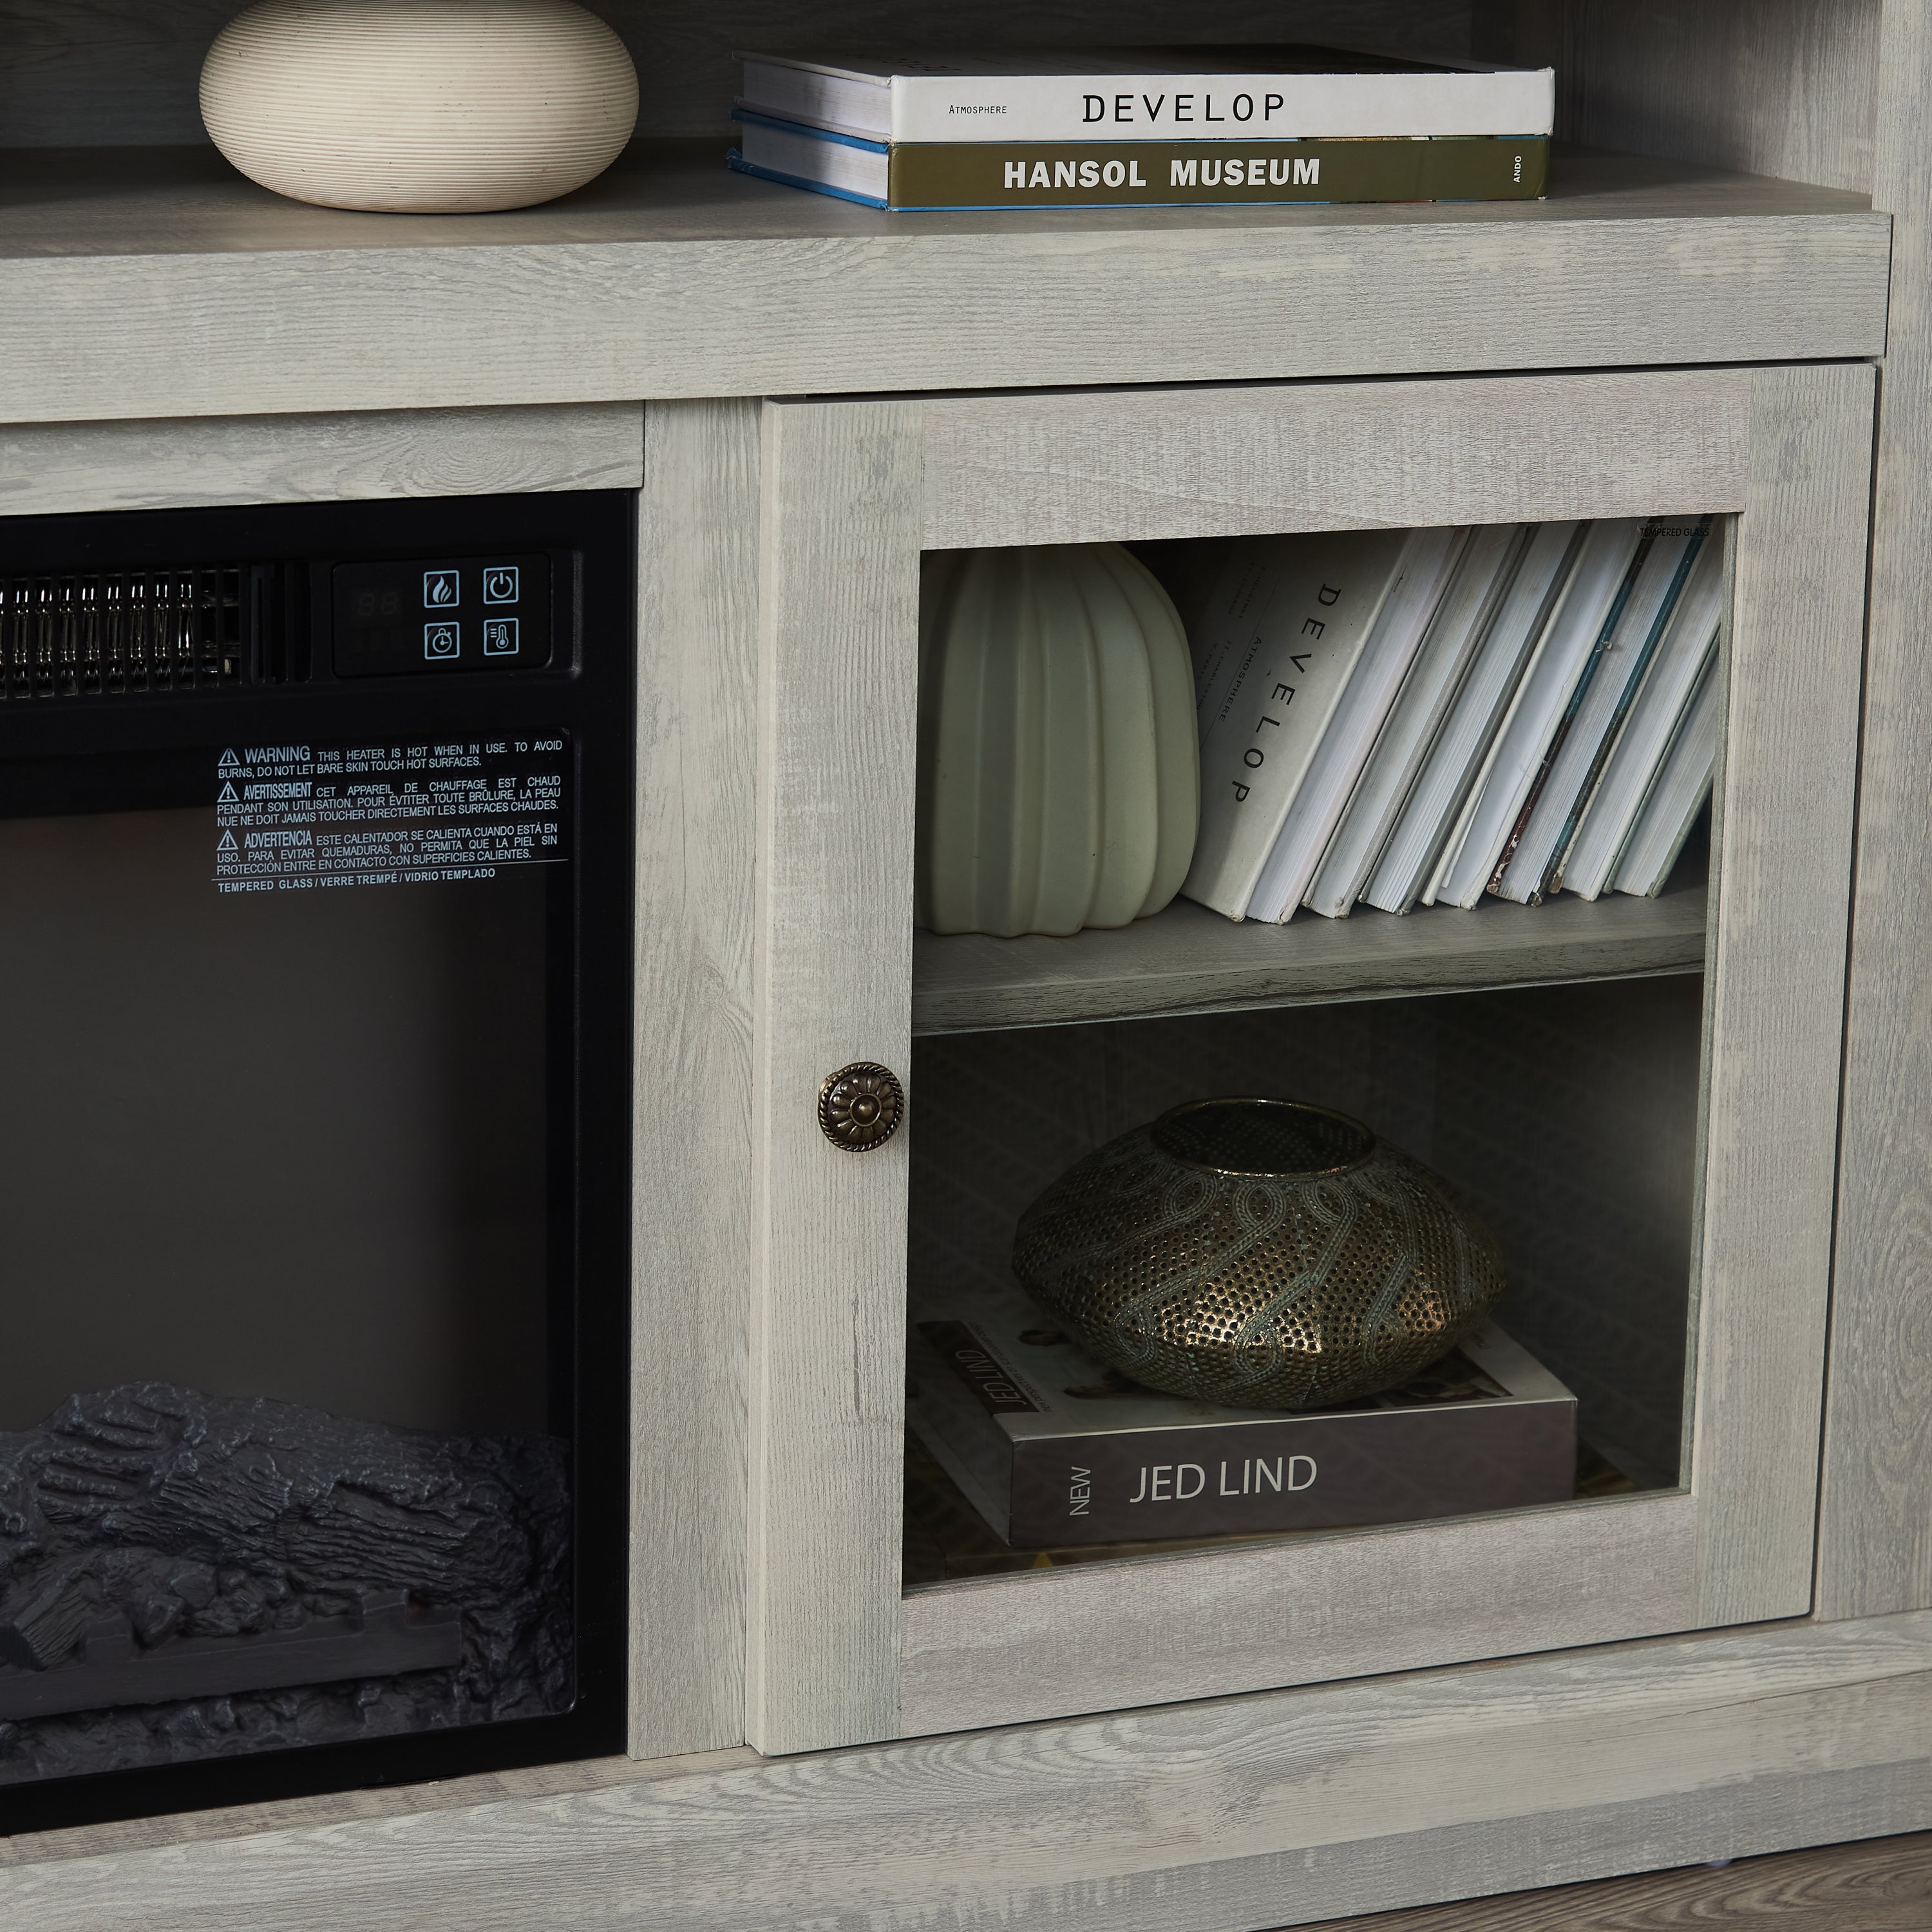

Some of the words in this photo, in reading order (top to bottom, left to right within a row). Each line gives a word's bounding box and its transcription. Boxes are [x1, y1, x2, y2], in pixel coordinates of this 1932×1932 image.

[1083, 93, 1284, 122] DEVELOP
[1004, 160, 1146, 188] HANSOL
[1170, 158, 1320, 187] MUSEUM
[1513, 155, 1522, 183] ANDO
[1640, 528, 1681, 536] TEMPERED
[1683, 528, 1709, 536] GLASS
[1219, 636, 1262, 722] ATMOSPHERE
[1232, 583, 1341, 802] DEVELOP
[244, 745, 310, 764] WARNING
[317, 751, 340, 762] THIS
[346, 748, 385, 760] HEATER
[392, 748, 401, 758] IS
[407, 746, 428, 757] HOT
[434, 744, 463, 756] WHEN
[469, 744, 479, 754] IN
[486, 743, 507, 753] USE.
[514, 742, 528, 752] TO
[534, 740, 563, 751] AVOID
[218, 767, 255, 779] BURNS,
[257, 766, 272, 777] DO
[274, 765, 295, 776] NOT
[297, 764, 316, 775] LET
[317, 762, 343, 774] BARE
[345, 761, 368, 773] SKIN
[370, 760, 404, 771] TOUCH
[406, 759, 427, 770] HOT
[428, 757, 482, 768] SURFACES.
[217, 802, 264, 815] PENDANT
[267, 801, 289, 812] SON
[292, 798, 353, 810] UTILISATION.
[357, 796, 385, 807] POUR
[389, 793, 430, 806] ÉVTITER
[433, 792, 465, 804] TOUTE
[469, 789, 516, 802] BRÛLURE,
[520, 789, 532, 799] LA
[535, 787, 561, 799] PEAU
[243, 781, 313, 800] AVERTISSEMENT
[316, 786, 336, 797] CET
[346, 784, 393, 796] APPAREIL
[404, 782, 419, 793] DE
[429, 779, 487, 792] CHAUFFAGE
[498, 777, 517, 788] EST
[527, 775, 561, 787] CHAUD
[217, 816, 238, 827] NUE
[240, 815, 254, 826] NE
[256, 813, 279, 825] DOIT
[281, 812, 316, 824] JAMAIS
[318, 810, 366, 821] TOUCHER
[368, 806, 436, 819] DIRECTEMENT
[438, 804, 457, 816] LES
[458, 802, 509, 814] SURFACES
[511, 799, 559, 811] CHAUDES.
[217, 852, 241, 863] USO.
[248, 850, 274, 861] PARA
[281, 848, 315, 860] EVITAR
[322, 844, 392, 857] QUEMADURAS,
[399, 842, 414, 853] NO
[421, 840, 463, 852] PERMITA
[469, 838, 489, 850] QUE
[496, 838, 509, 848] LA
[514, 837, 535, 847] PIEL
[541, 835, 558, 845] SIN
[244, 830, 313, 849] ADVERTENCIA
[316, 835, 341, 846] ESTE
[344, 831, 408, 844] CALENTADOR
[411, 829, 424, 840] SE
[426, 828, 472, 840] CALIENTA
[473, 825, 515, 837] CUANDO
[517, 821, 542, 835] ESTÁ
[544, 823, 558, 833] EN
[216, 860, 281, 876] PROTECCIÓN
[283, 860, 316, 871] ENTRE
[318, 859, 332, 869] EN
[334, 857, 386, 869] CONTACTO
[388, 855, 410, 866] CON
[412, 851, 475, 864] SUPERFICIES
[477, 848, 531, 861] CALIENTES.
[218, 880, 274, 893] TEMPERED
[279, 878, 313, 889] GLASS
[320, 876, 354, 887] VERRE
[356, 871, 397, 885] TREMPÉ
[404, 871, 439, 882] VIDRIO
[440, 868, 495, 880] TEMPLADO
[955, 1350, 1004, 1378] LIND
[983, 1382, 1027, 1405] JED
[1069, 1466, 1092, 1516] NEW
[1130, 1463, 1206, 1503] JED
[1220, 1455, 1317, 1496] LIND
